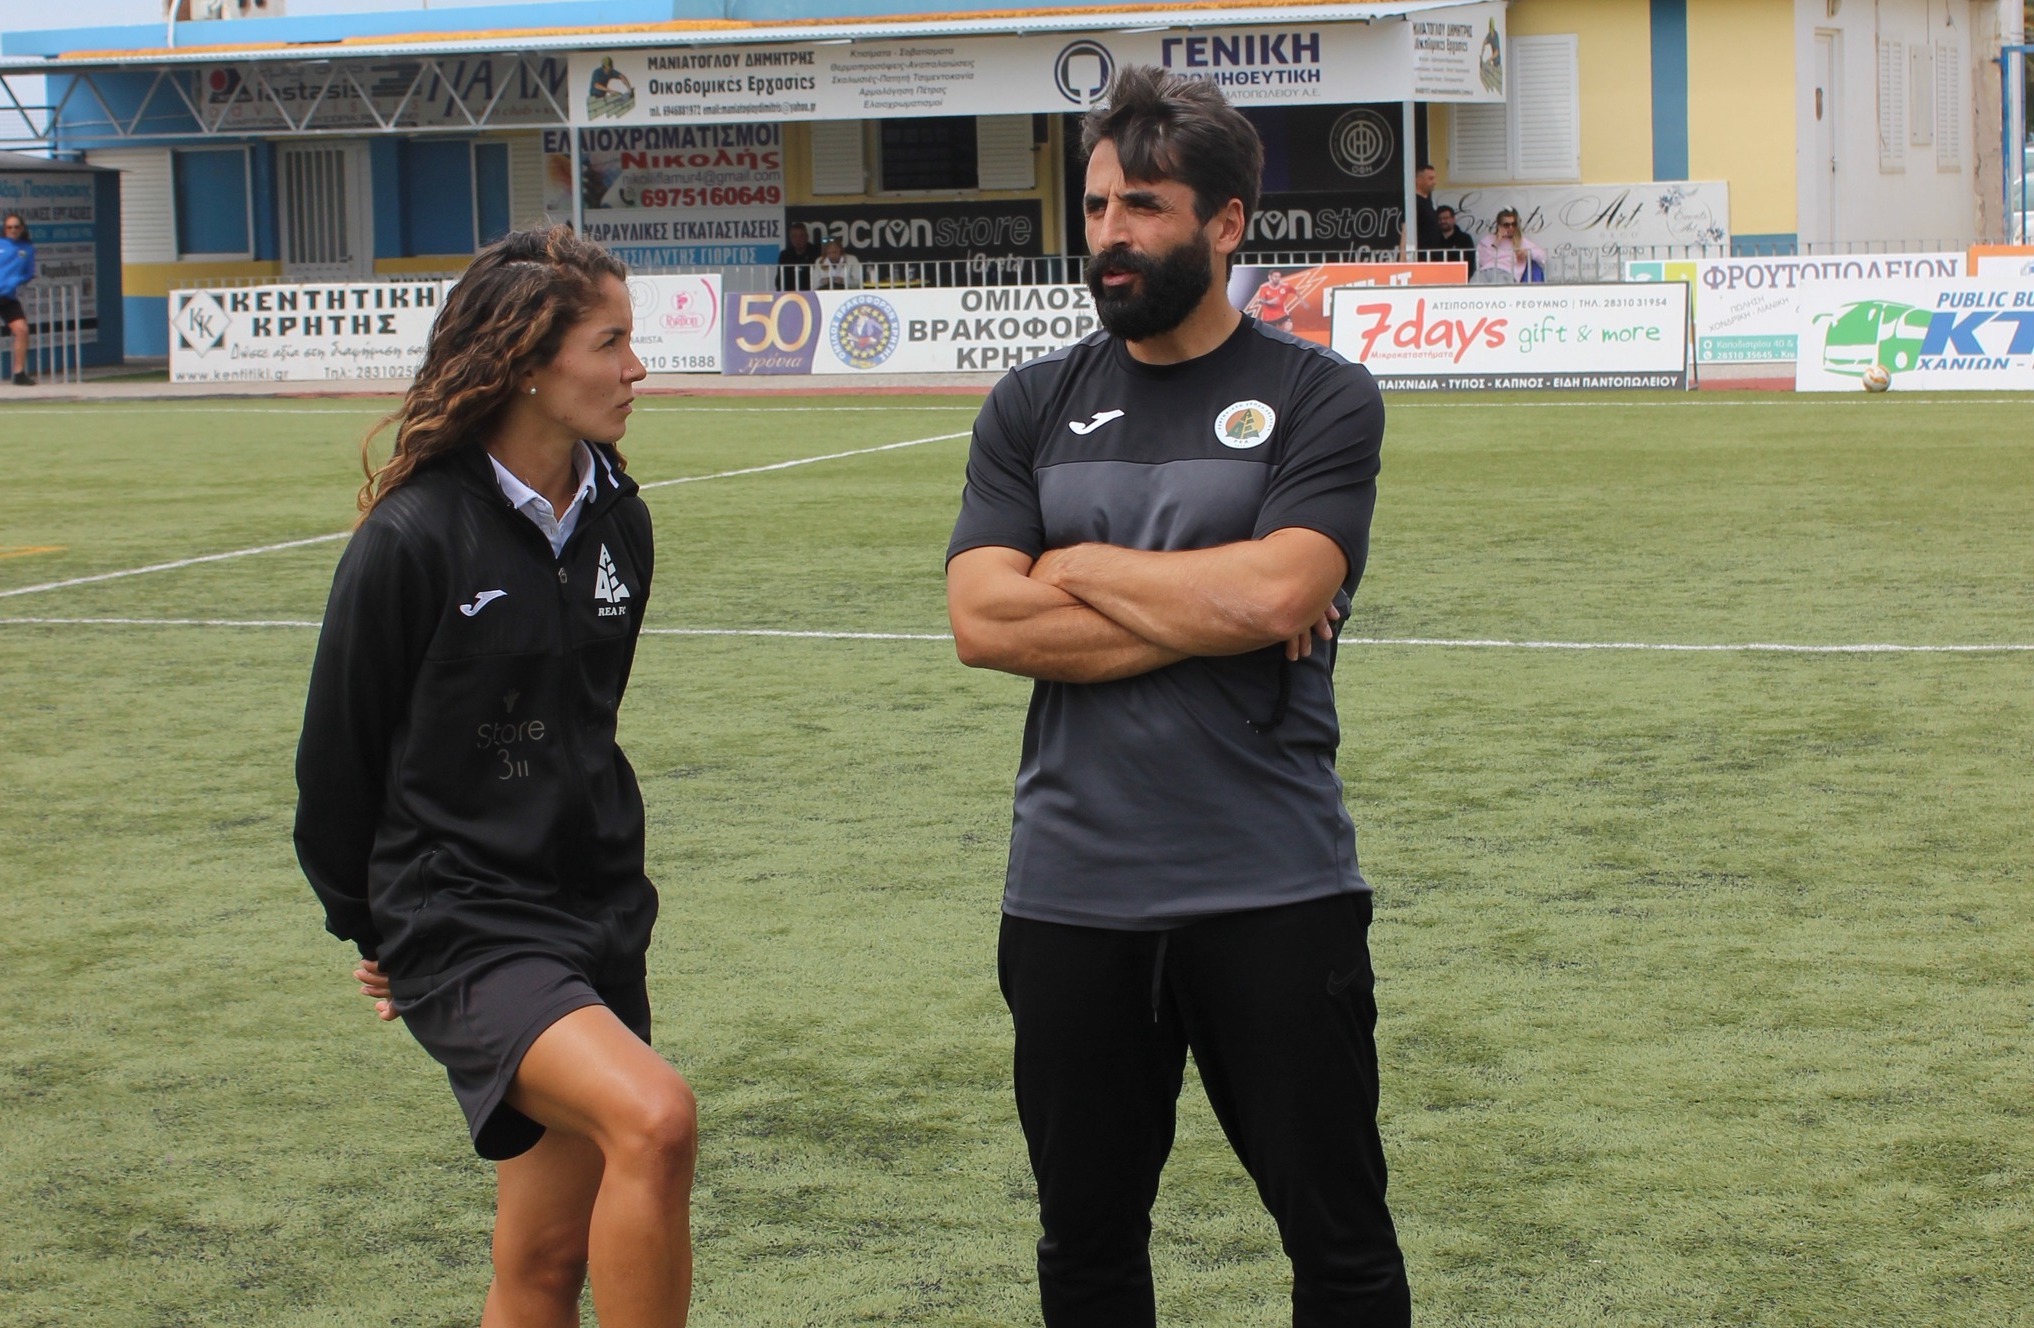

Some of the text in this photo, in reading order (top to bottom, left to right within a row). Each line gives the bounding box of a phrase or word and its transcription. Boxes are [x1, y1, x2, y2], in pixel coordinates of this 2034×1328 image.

[648, 51, 814, 70] ΜΑΝΙΑΤΟΓΛΟΥ ΔΗΜΗΤΡΗΣ
[1161, 32, 1320, 68] ΓΕΝΙΚΗ
[649, 73, 815, 97] Οικοδομικές Εργασίες
[543, 123, 780, 154] ΕΛΑΙΟΧΡΩΜΑΤΙΣΜΟΙ
[641, 185, 781, 208] 6975160649
[673, 219, 780, 240] ΕΓΚΑΤΑΣΤΑΣΕΙΣ
[935, 215, 1031, 247] store
[701, 247, 757, 265] ΓΙΩΡΓΟΣ
[230, 287, 435, 312] ΚΕΝΤΗΤΙΚΗ
[961, 287, 1091, 312] ΟΜΙΛΟΣ
[1432, 301, 1506, 310] ΑΤΣΙΠΟΠΟΥΛΟ
[1516, 300, 1568, 309] ΡΕΘΥΜΝΟ
[1604, 298, 1634, 308] 28310
[1637, 298, 1667, 307] 31954
[1936, 291, 2008, 308] PUBLIC
[252, 314, 397, 337] ΚΡΗΤΗΣ
[735, 292, 813, 353] 50
[908, 315, 1105, 342] ΒΡΑΚΟΦΟΡ
[1355, 297, 1509, 364] 7days
[1518, 315, 1661, 354] gift & more
[672, 355, 715, 368] 51888
[738, 352, 804, 374] χρόνια
[957, 346, 1056, 370] ΚΡΗΤ
[1917, 357, 2011, 371] ΧΑΝΙΩΝ
[175, 367, 289, 380] www.kentitiki.gr
[1378, 376, 1678, 391] ΠΑΙΧΝΙΔΙΑ ΤΥΠΟΣ ΚΑΠΝΟΣ ΕΙΔΗ ΠΑΝΤΟΠΩΛΕΙΟΥ
[598, 606, 618, 617] REA
